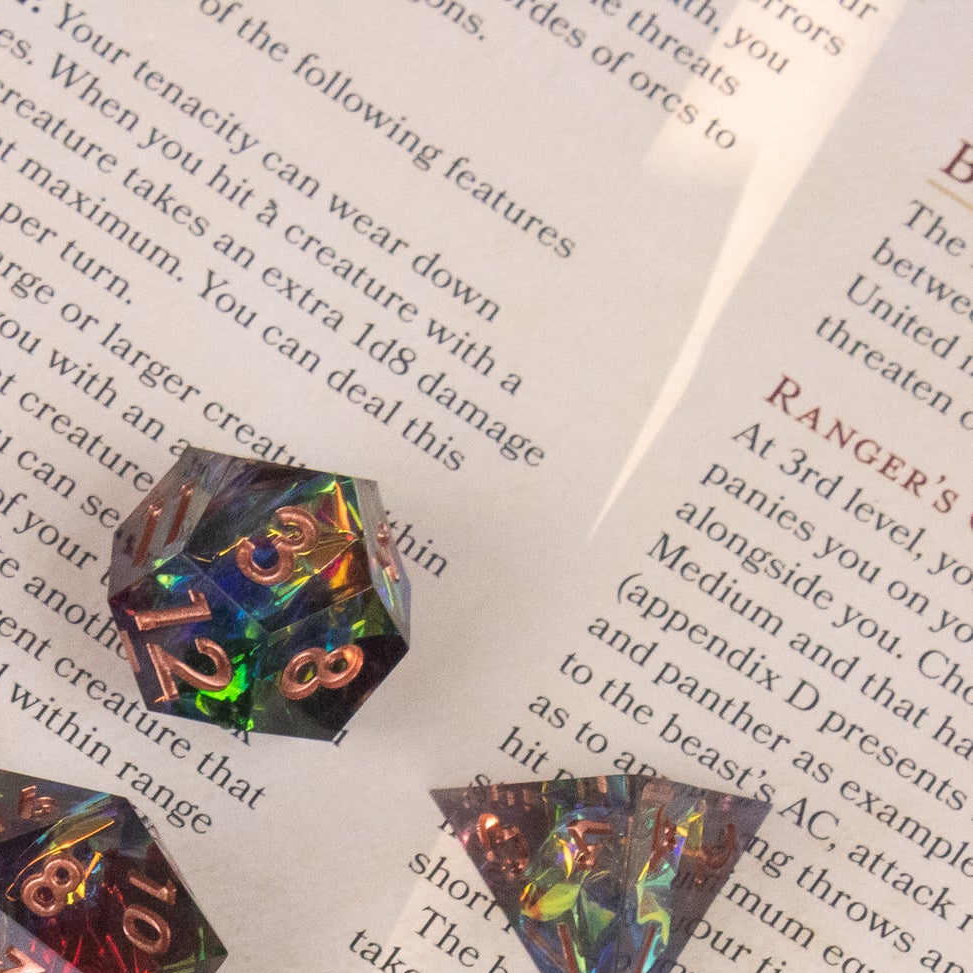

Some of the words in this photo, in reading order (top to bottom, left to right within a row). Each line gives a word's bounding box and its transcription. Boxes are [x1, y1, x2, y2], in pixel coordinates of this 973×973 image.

[590, 45, 635, 73] of
[628, 70, 695, 124] orcs
[625, 9, 735, 96] threats
[49, 51, 140, 132] When
[205, 162, 254, 209] hit
[283, 223, 419, 323] creature
[55, 0, 131, 65] Your
[132, 59, 259, 155] tenacity
[261, 150, 320, 199] can
[328, 192, 410, 255] wear
[410, 252, 500, 322] down
[235, 16, 289, 62] the
[292, 52, 444, 172] following
[442, 155, 575, 259] features
[16, 157, 183, 282] maximum.
[903, 198, 966, 257] The
[121, 166, 210, 237] takes
[260, 265, 344, 333] extra
[352, 321, 417, 376] 1d8
[415, 371, 545, 467] damage
[814, 314, 953, 415] threaten
[845, 273, 960, 360] United
[731, 421, 775, 460] At
[778, 447, 844, 501] 3rd
[840, 486, 926, 562] level,
[764, 374, 960, 514] RANGER'S
[235, 506, 318, 586] 3
[698, 462, 816, 542] panies
[646, 530, 784, 637] Medium
[674, 501, 834, 610] alongside
[830, 603, 903, 660] you.
[134, 588, 232, 703] 12
[281, 644, 364, 701] 8
[615, 571, 782, 693] (appendix
[814, 709, 968, 811] presents
[9, 681, 112, 767] within
[113, 760, 213, 835] range
[651, 660, 792, 753] panther
[21, 855, 85, 917] 8
[123, 868, 177, 954] 10
